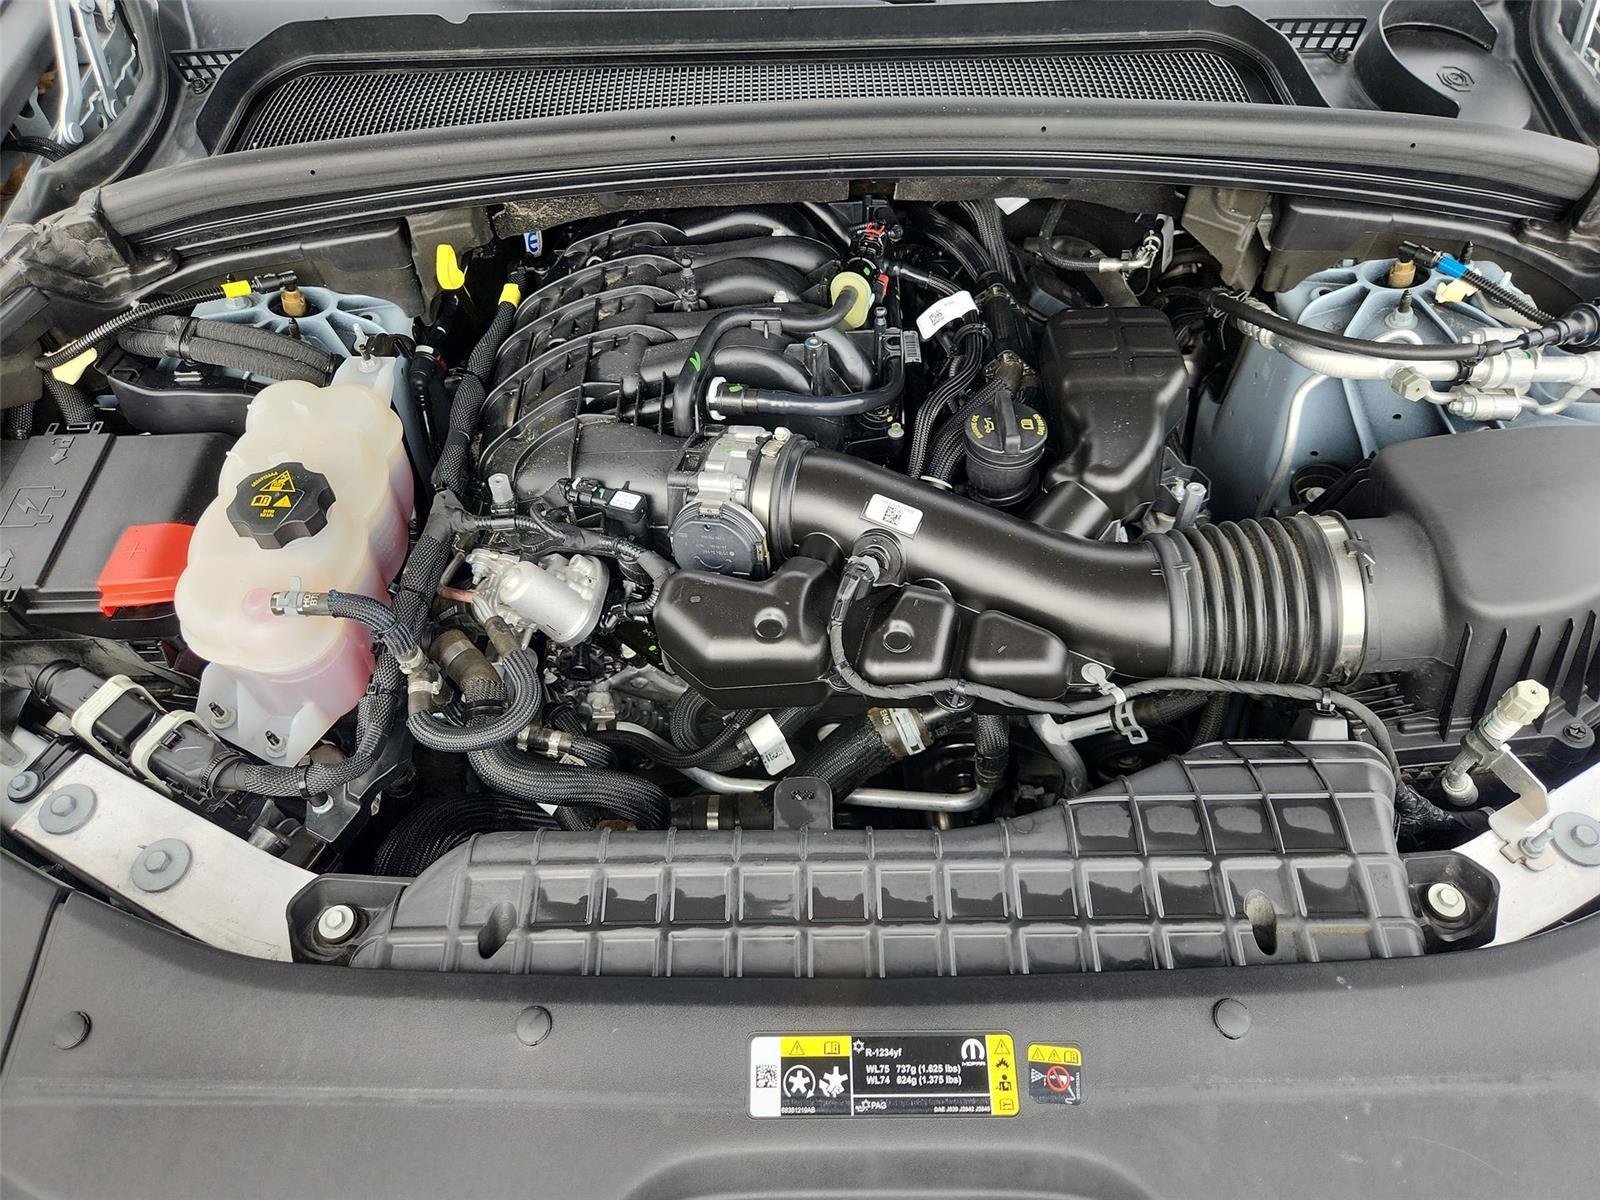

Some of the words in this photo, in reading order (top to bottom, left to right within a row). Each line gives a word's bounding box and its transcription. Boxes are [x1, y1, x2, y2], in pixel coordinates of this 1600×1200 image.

[865, 1048, 902, 1058] R-1234yf
[865, 1064, 890, 1074] WL75
[896, 1065, 917, 1075] 737g
[918, 1064, 943, 1075] (1.625
[945, 1064, 961, 1074] lbs)
[865, 1075, 891, 1085] WL74
[896, 1075, 917, 1086] 624g
[918, 1075, 944, 1086] (1.375
[945, 1075, 962, 1085] lbs)
[871, 1101, 887, 1110] PAG
